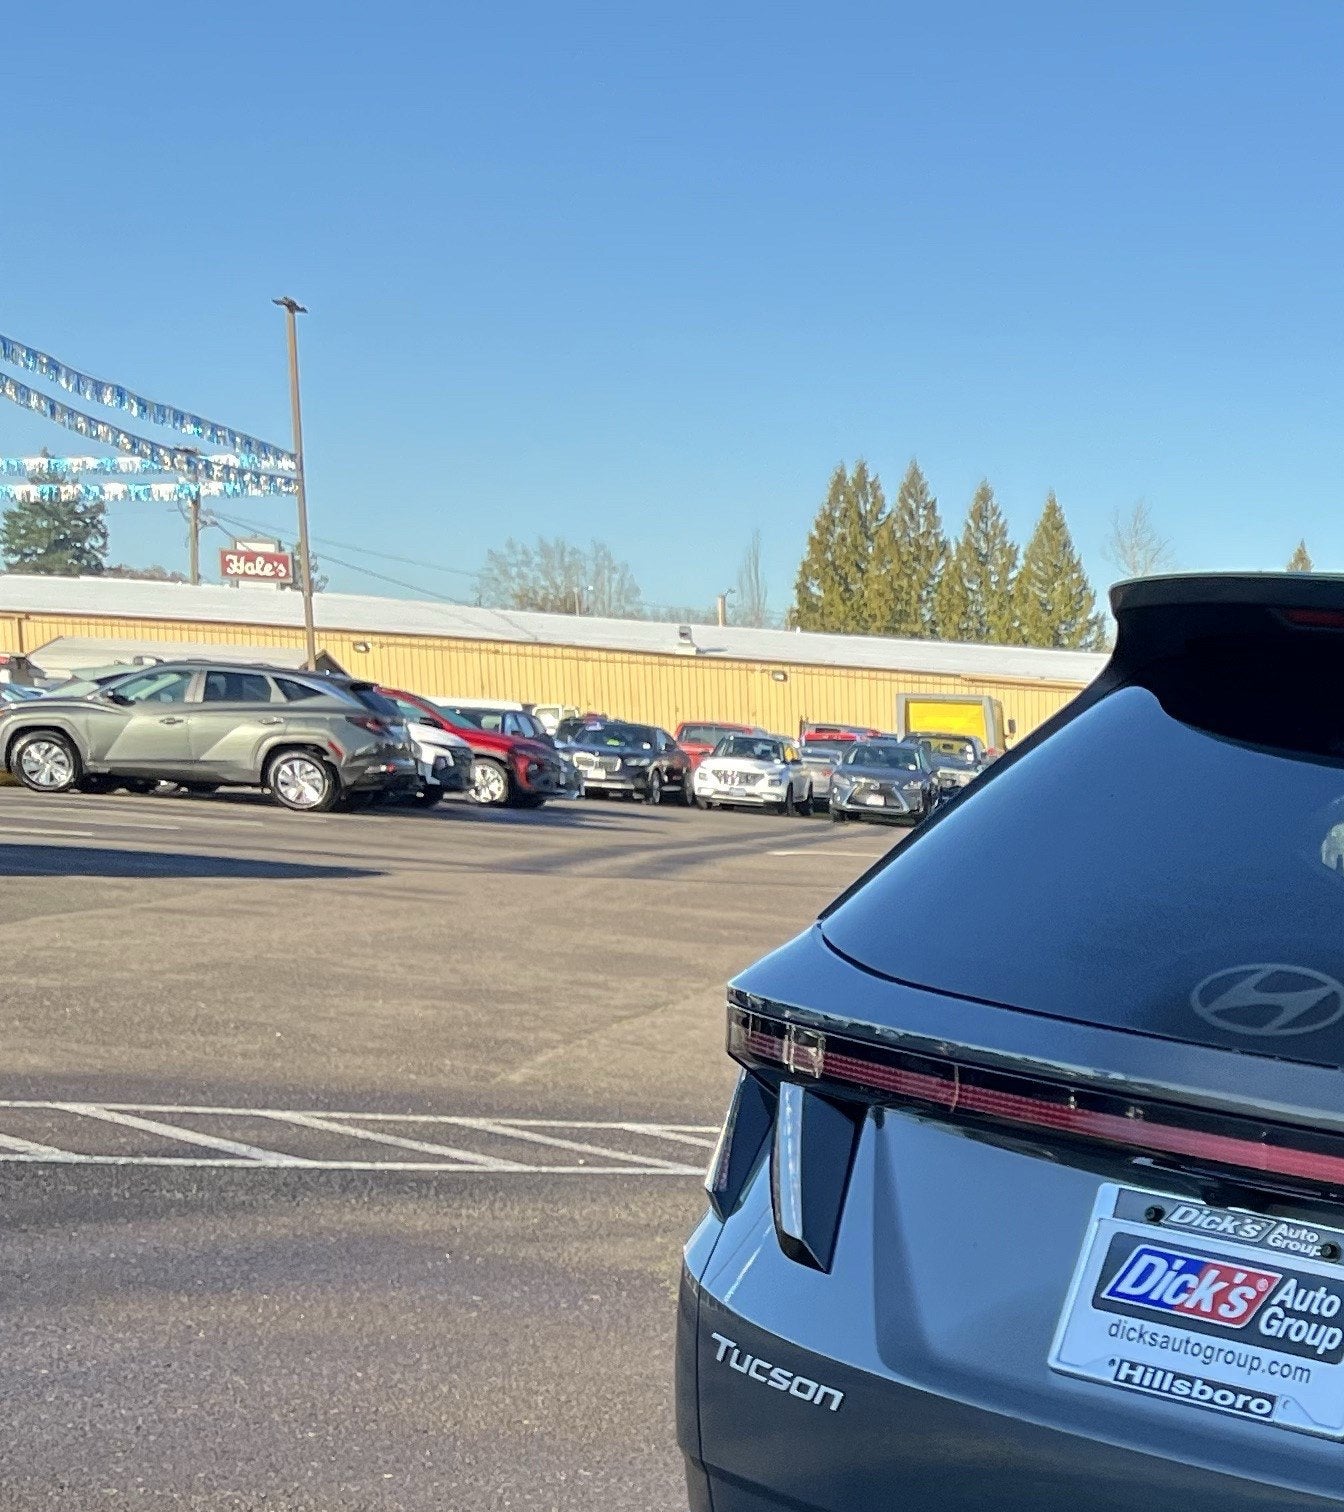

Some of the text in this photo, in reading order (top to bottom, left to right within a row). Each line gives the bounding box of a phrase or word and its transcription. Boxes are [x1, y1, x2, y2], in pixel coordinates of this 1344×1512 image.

[225, 554, 287, 577] Hale's
[1168, 1205, 1320, 1243] Dick's Auto
[1115, 1253, 1342, 1319] Dick's Auto
[1108, 1319, 1312, 1384] dicksautogroup.com
[1259, 1307, 1344, 1354] Group
[711, 1332, 844, 1411] Tucson
[1116, 1359, 1273, 1415] Hillsboro
